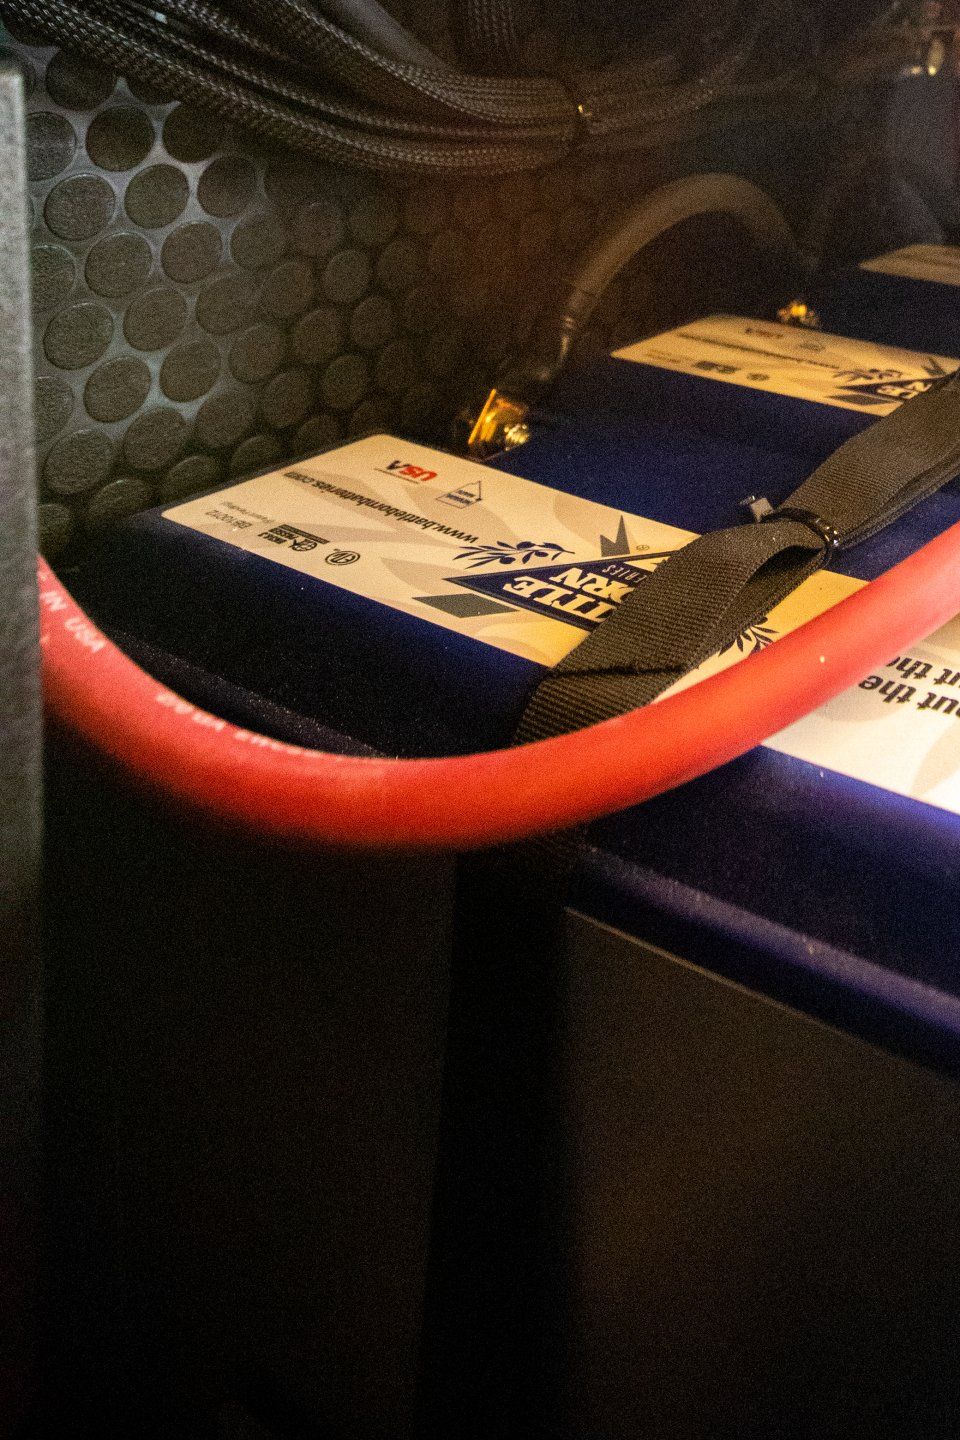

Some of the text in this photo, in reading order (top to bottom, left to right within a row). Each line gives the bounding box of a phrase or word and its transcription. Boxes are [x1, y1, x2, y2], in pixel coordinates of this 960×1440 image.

[386, 460, 438, 482] USA
[283, 471, 479, 544] www.battlebornbatteries.com
[502, 575, 617, 623] TTLE
